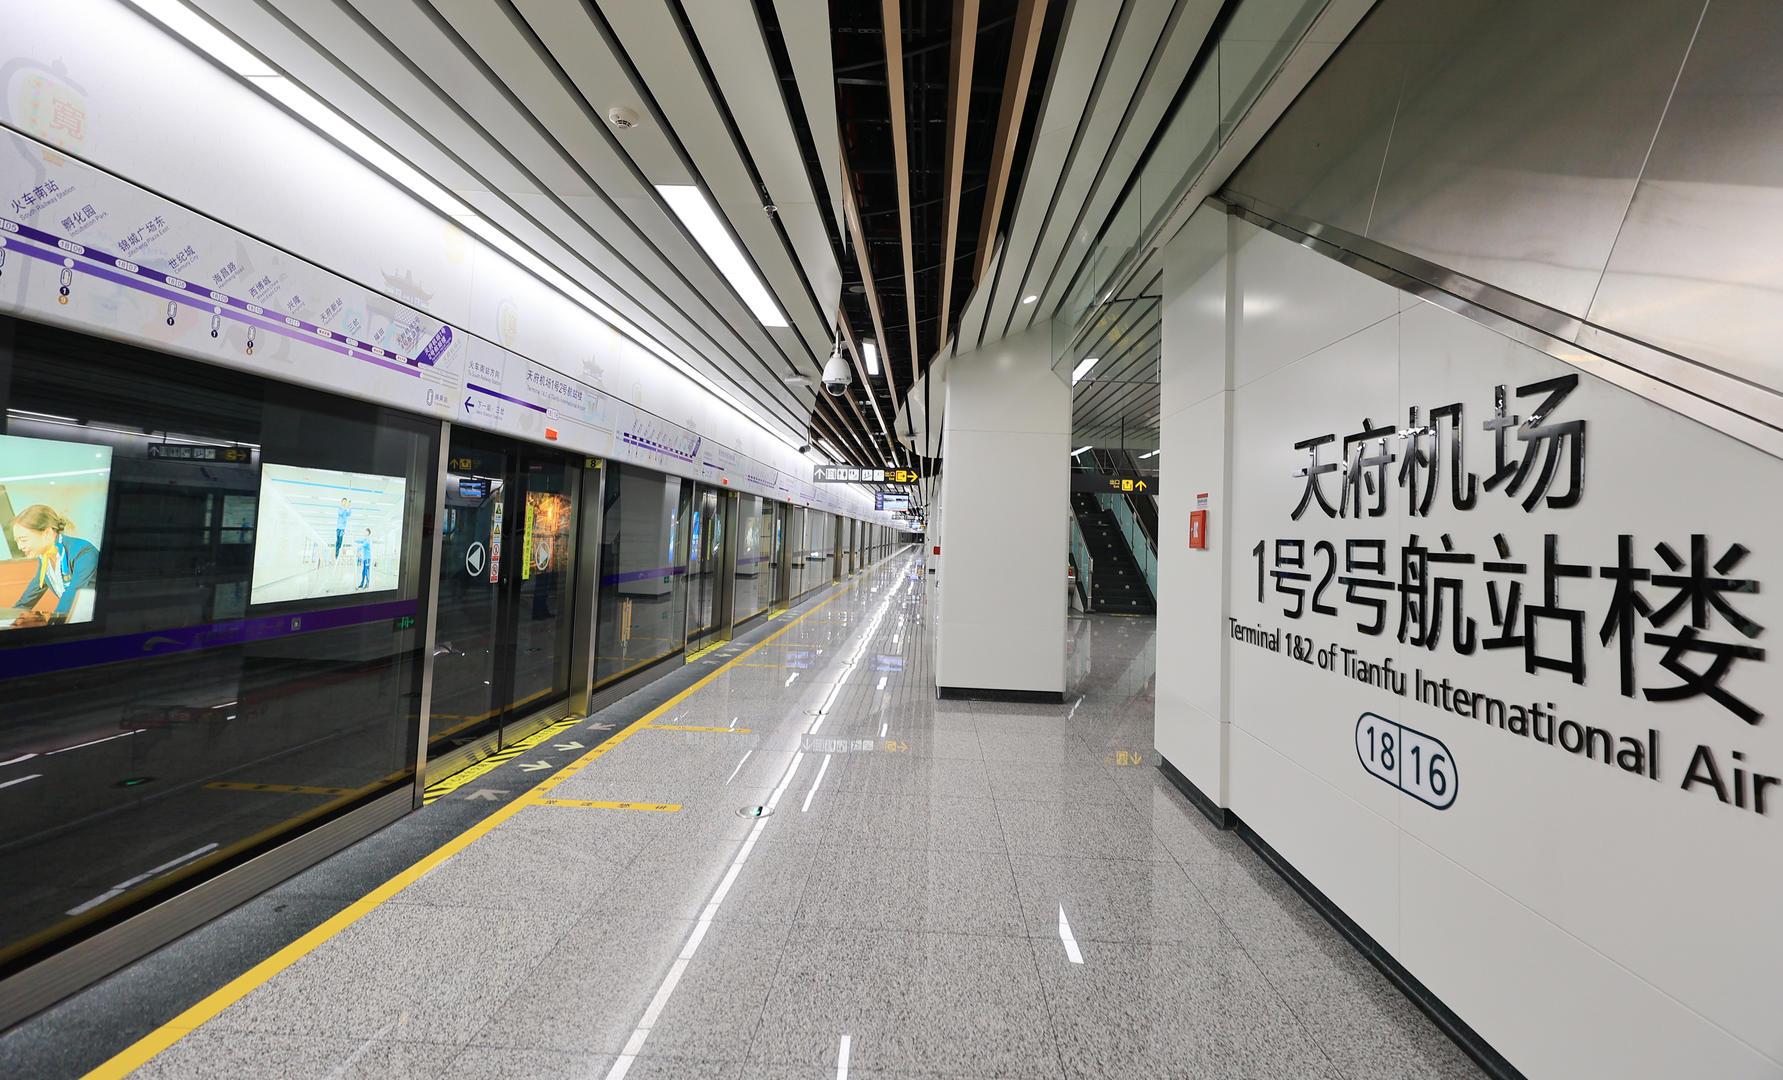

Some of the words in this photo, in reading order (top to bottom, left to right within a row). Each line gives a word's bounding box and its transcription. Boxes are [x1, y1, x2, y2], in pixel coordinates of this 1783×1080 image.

[11, 180, 59, 214] 火车南站
[1290, 373, 1587, 521] 天府机场
[1251, 532, 1765, 725] 1号2号航站楼
[1229, 617, 1280, 652] Terminal
[1286, 632, 1314, 664] 1&2
[1318, 643, 1338, 672] of
[1340, 647, 1406, 696] Tianfu
[1416, 668, 1661, 783] International
[1680, 744, 1782, 816] Air
[1366, 726, 1394, 770] 18
[1410, 745, 1446, 796] 16
